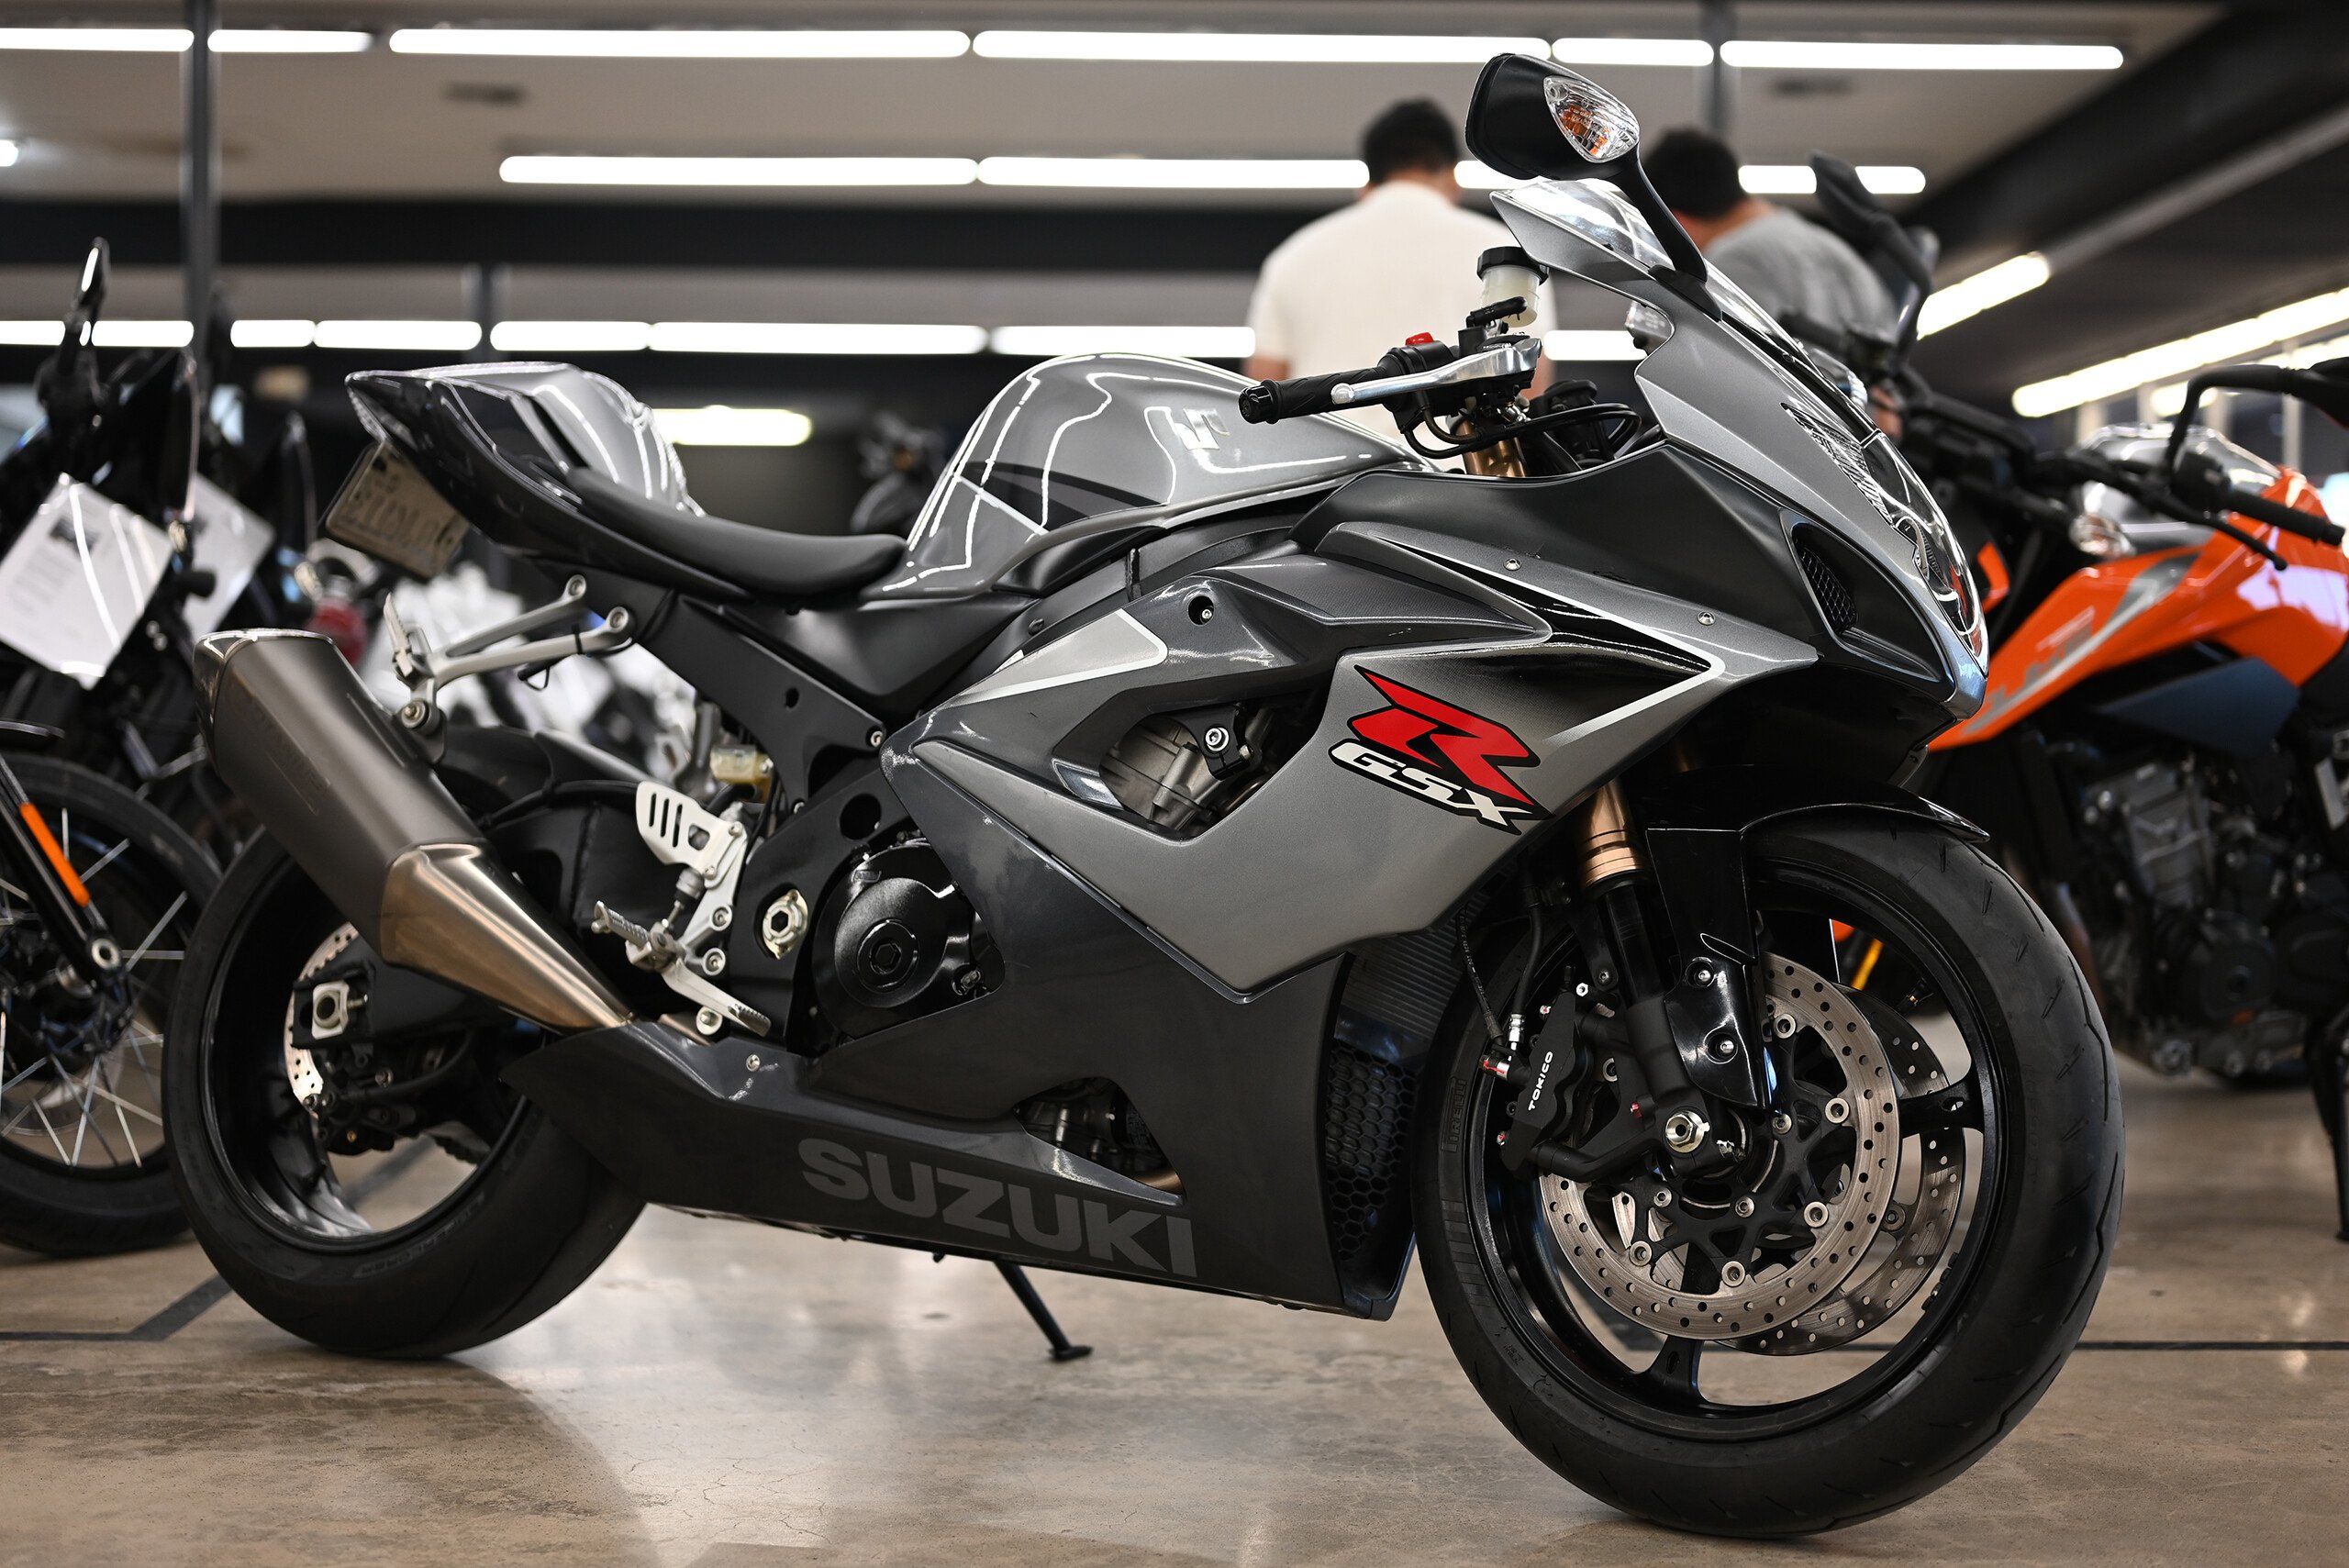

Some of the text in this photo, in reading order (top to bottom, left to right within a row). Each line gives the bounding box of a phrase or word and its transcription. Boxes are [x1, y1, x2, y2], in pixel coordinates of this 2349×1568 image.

[1352, 668, 1541, 807] R
[1330, 740, 1536, 828] GSX
[1442, 1077, 1467, 1153] PIRELLI
[1528, 1051, 1553, 1111] TOKICO
[798, 1139, 1197, 1277] SUZUKI
